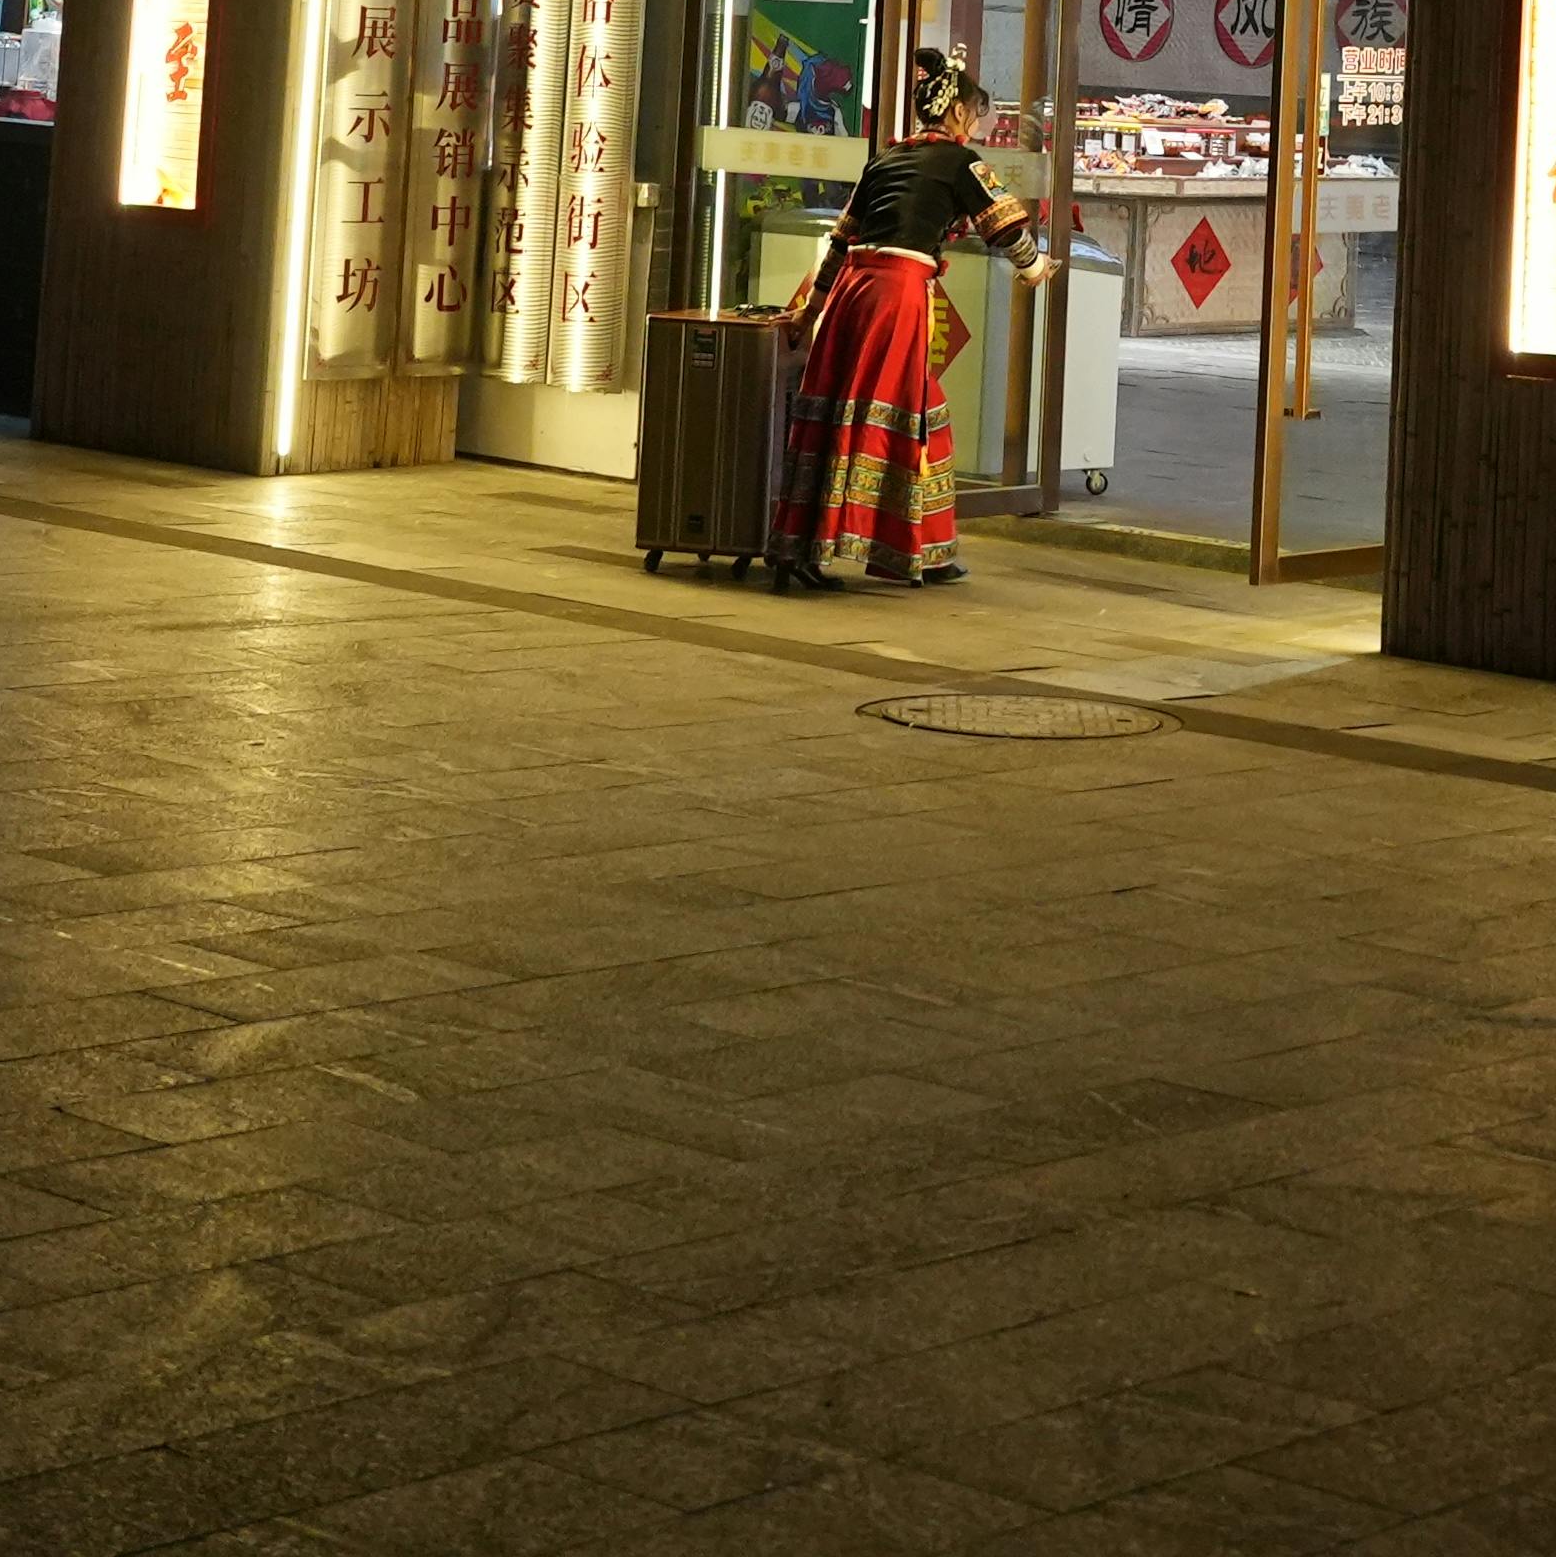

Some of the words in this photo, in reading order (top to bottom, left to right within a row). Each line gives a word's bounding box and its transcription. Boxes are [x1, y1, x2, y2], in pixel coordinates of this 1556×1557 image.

[1342, 46, 1406, 75] 营业时间
[1338, 82, 1403, 105] 上午10:3
[1338, 104, 1403, 126] 下午21:3
